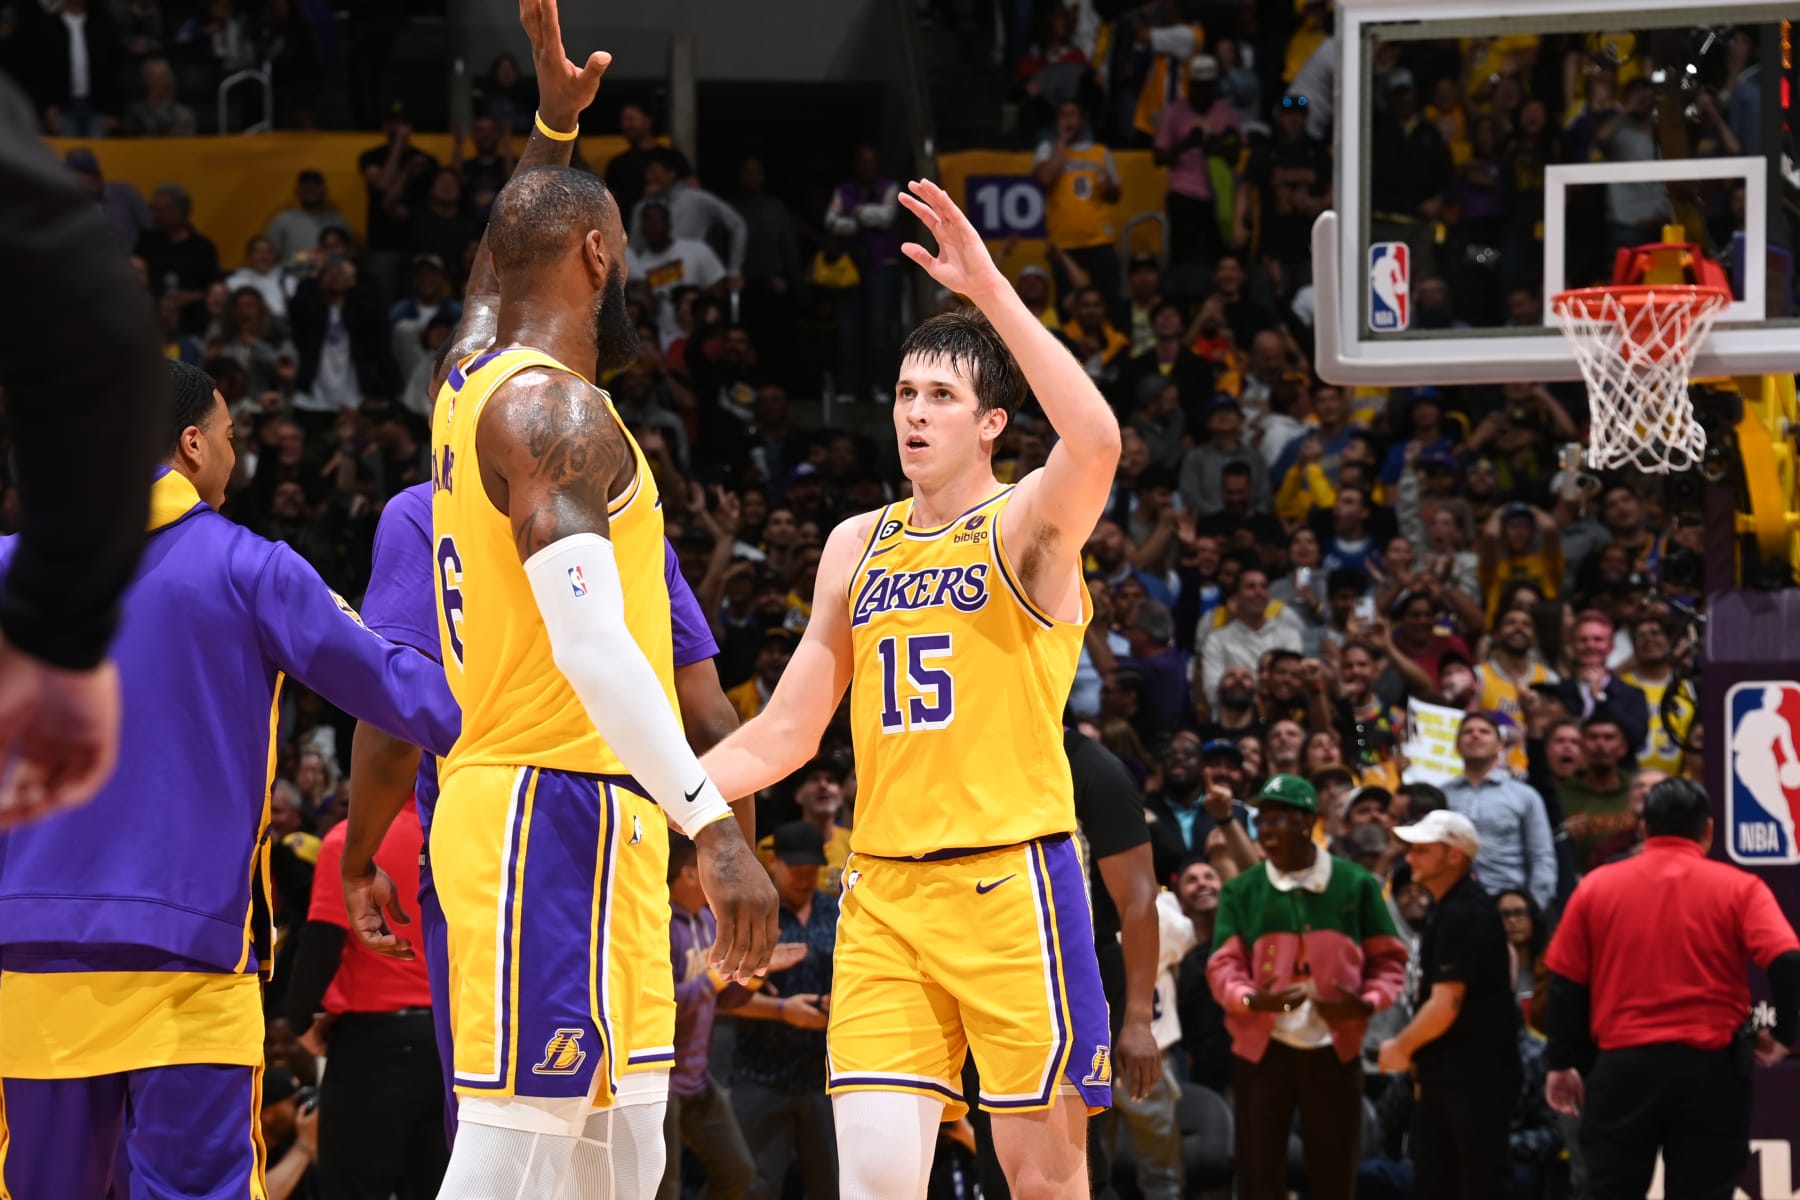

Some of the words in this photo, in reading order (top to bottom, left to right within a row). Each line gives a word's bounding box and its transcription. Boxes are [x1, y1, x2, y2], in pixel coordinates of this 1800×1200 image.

[975, 182, 1045, 231] 10
[881, 521, 899, 538] 6
[953, 530, 988, 544] bibigo
[851, 563, 990, 629] LAKERS
[877, 632, 955, 735] 15
[1738, 821, 1780, 853] NBA
